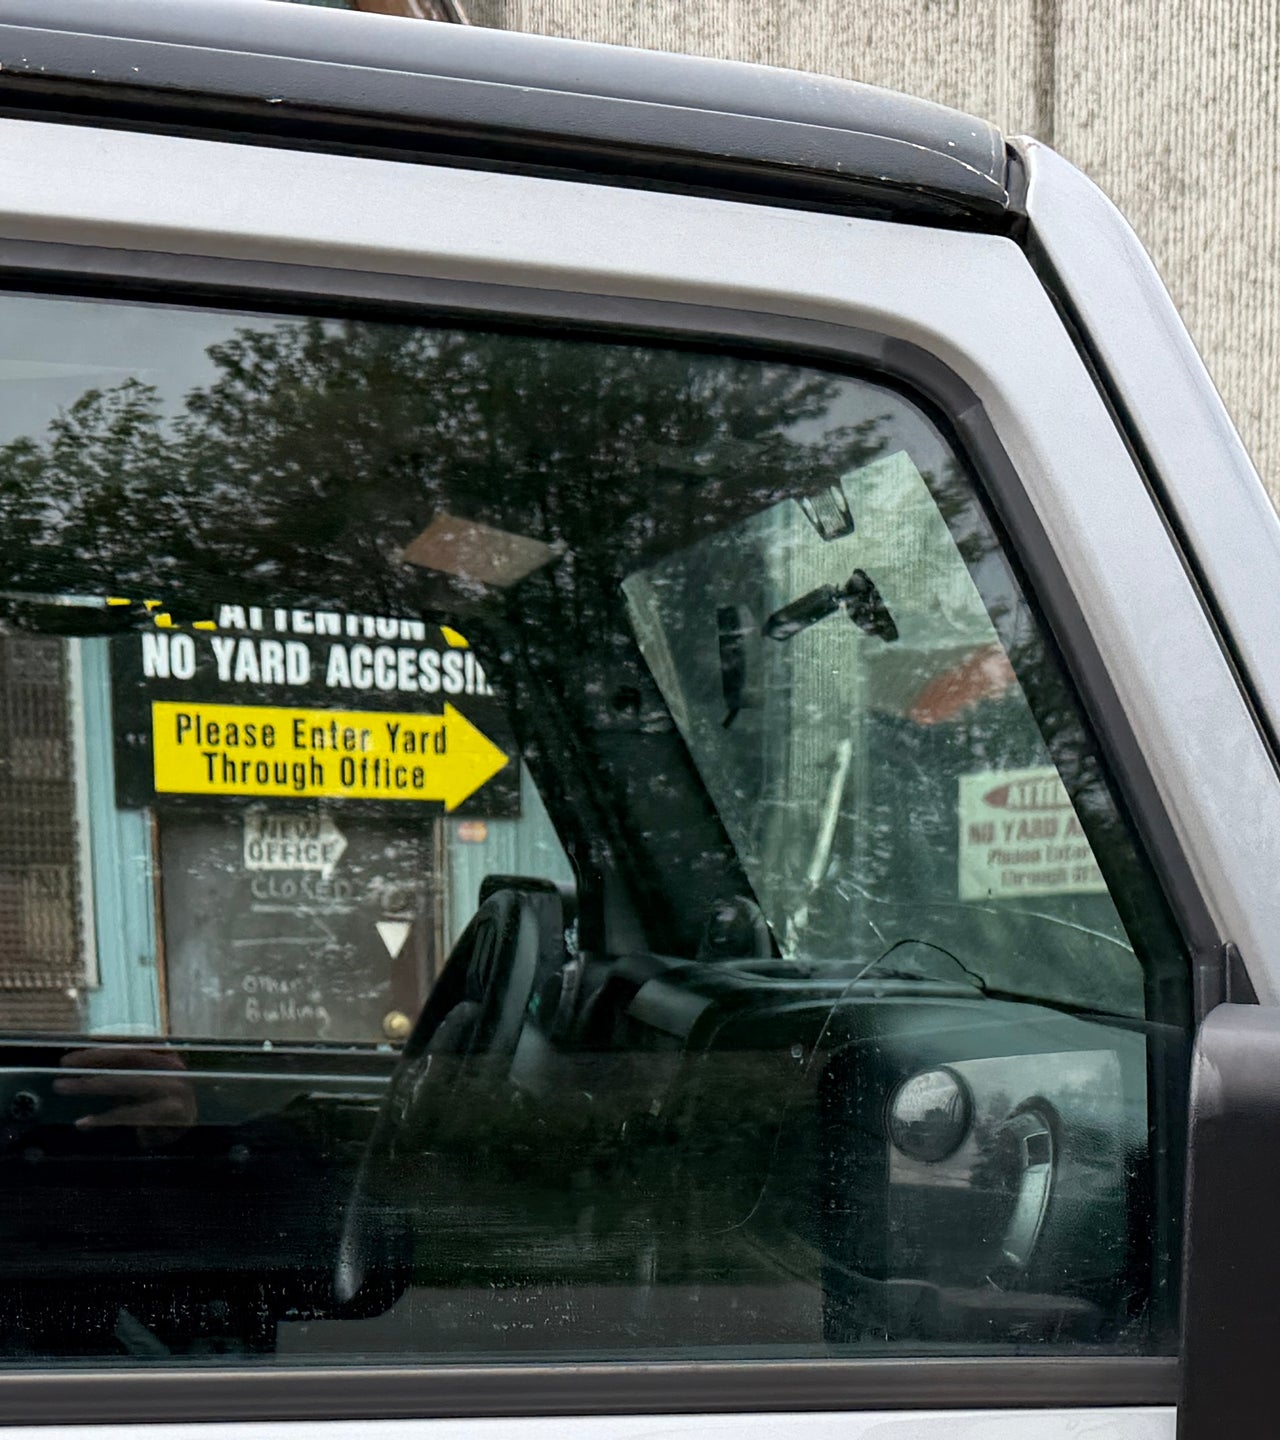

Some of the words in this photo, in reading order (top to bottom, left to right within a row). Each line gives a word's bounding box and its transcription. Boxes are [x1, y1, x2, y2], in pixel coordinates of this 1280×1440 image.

[141, 633, 195, 680] NO
[211, 638, 311, 686] YARD
[176, 713, 275, 749] Please
[293, 718, 371, 753] Enter
[387, 724, 447, 755] Yard
[202, 752, 324, 790] Through
[340, 757, 425, 789] Office
[249, 840, 337, 863] OFFICE
[251, 874, 352, 901] CLOSED
